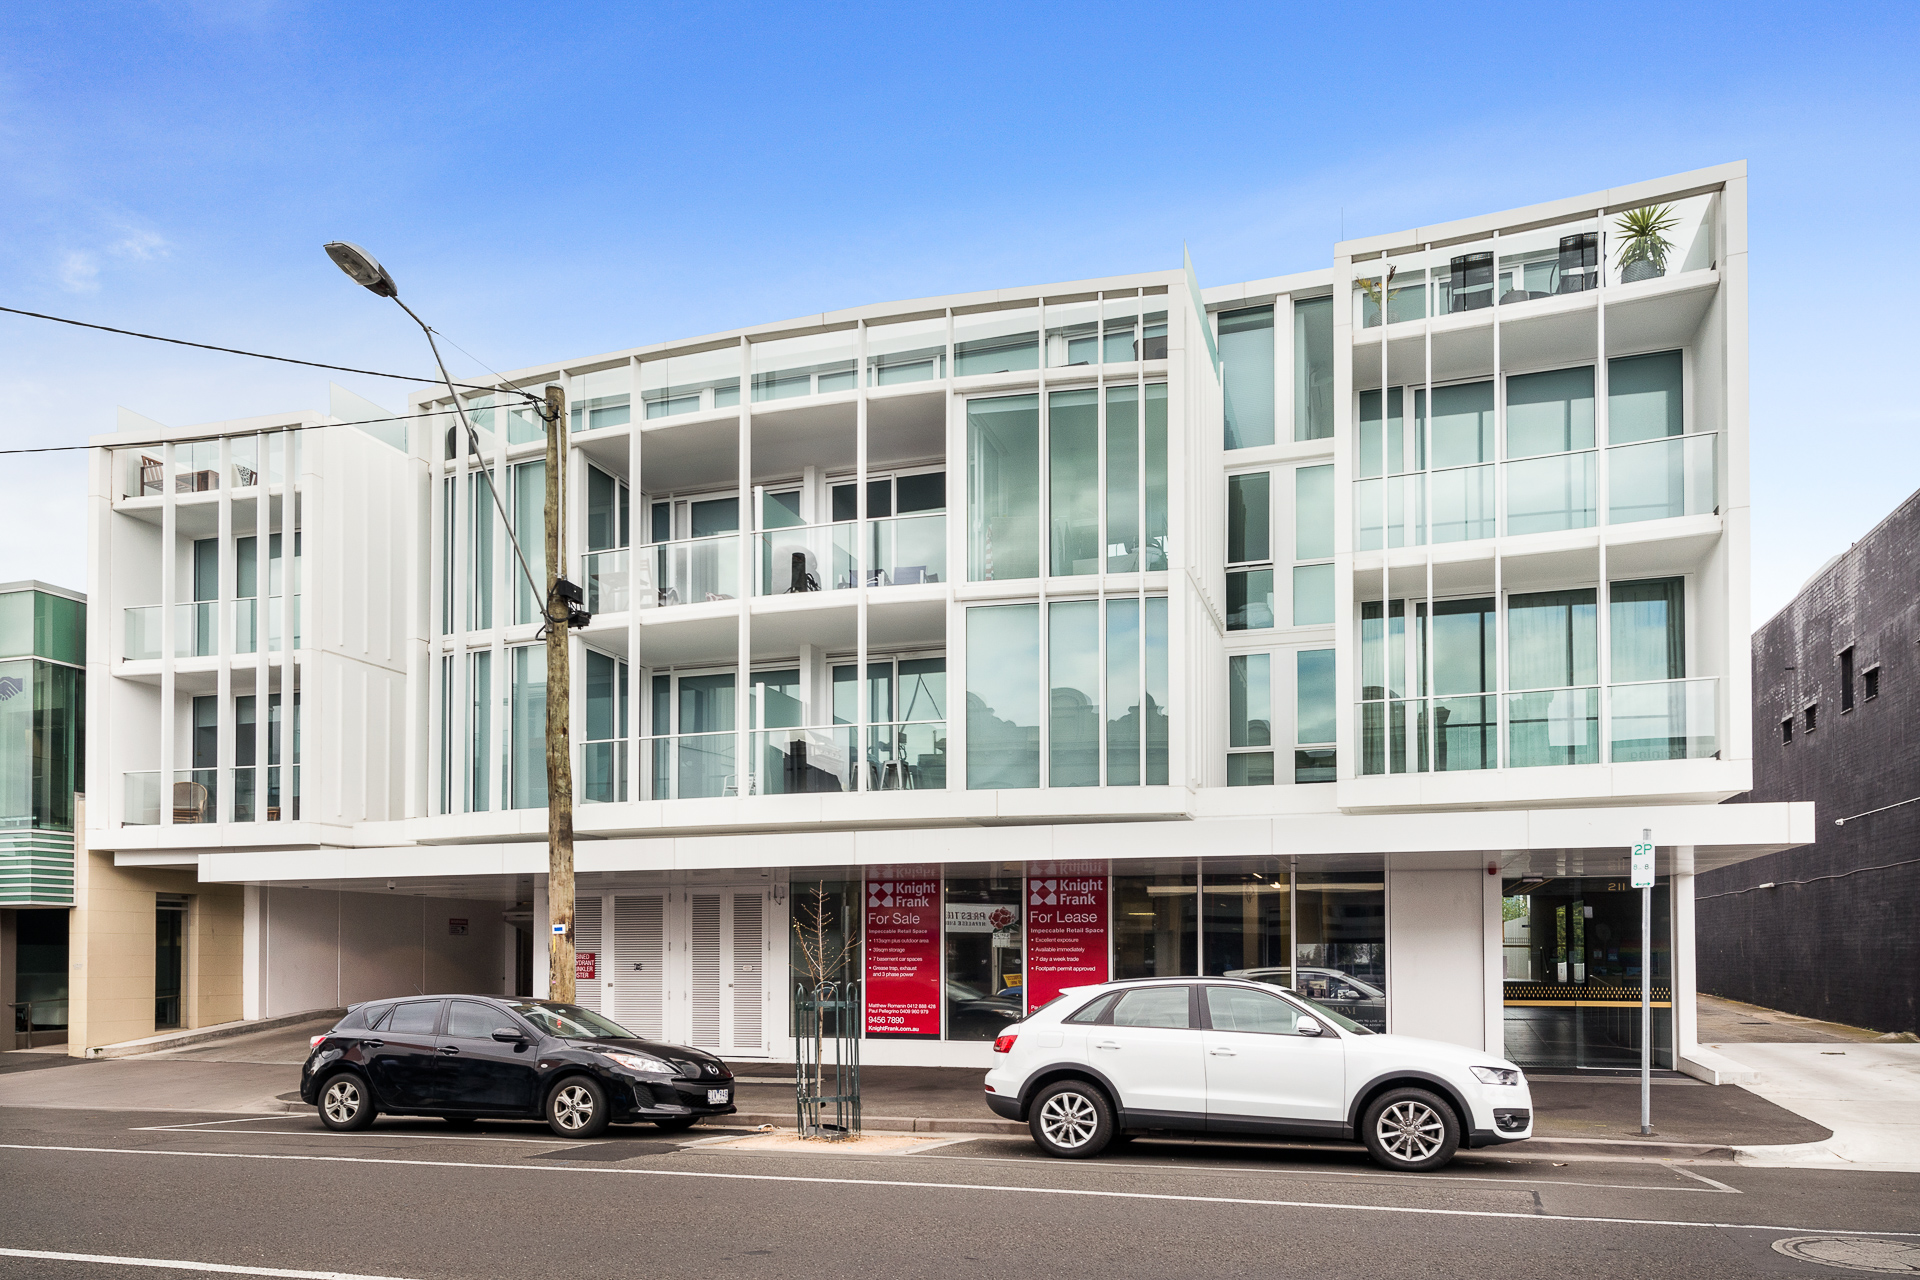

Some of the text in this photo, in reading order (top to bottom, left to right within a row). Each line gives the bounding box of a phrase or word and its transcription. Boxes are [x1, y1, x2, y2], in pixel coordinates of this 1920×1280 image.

[1634, 844, 1652, 856] 2P
[896, 882, 936, 896] Knight
[1060, 879, 1103, 894] Knight
[1608, 883, 1625, 891] 211
[896, 896, 930, 908] Frank
[1060, 894, 1096, 905] Frank
[868, 912, 920, 924] For Sale
[1030, 911, 1098, 923] For Lease
